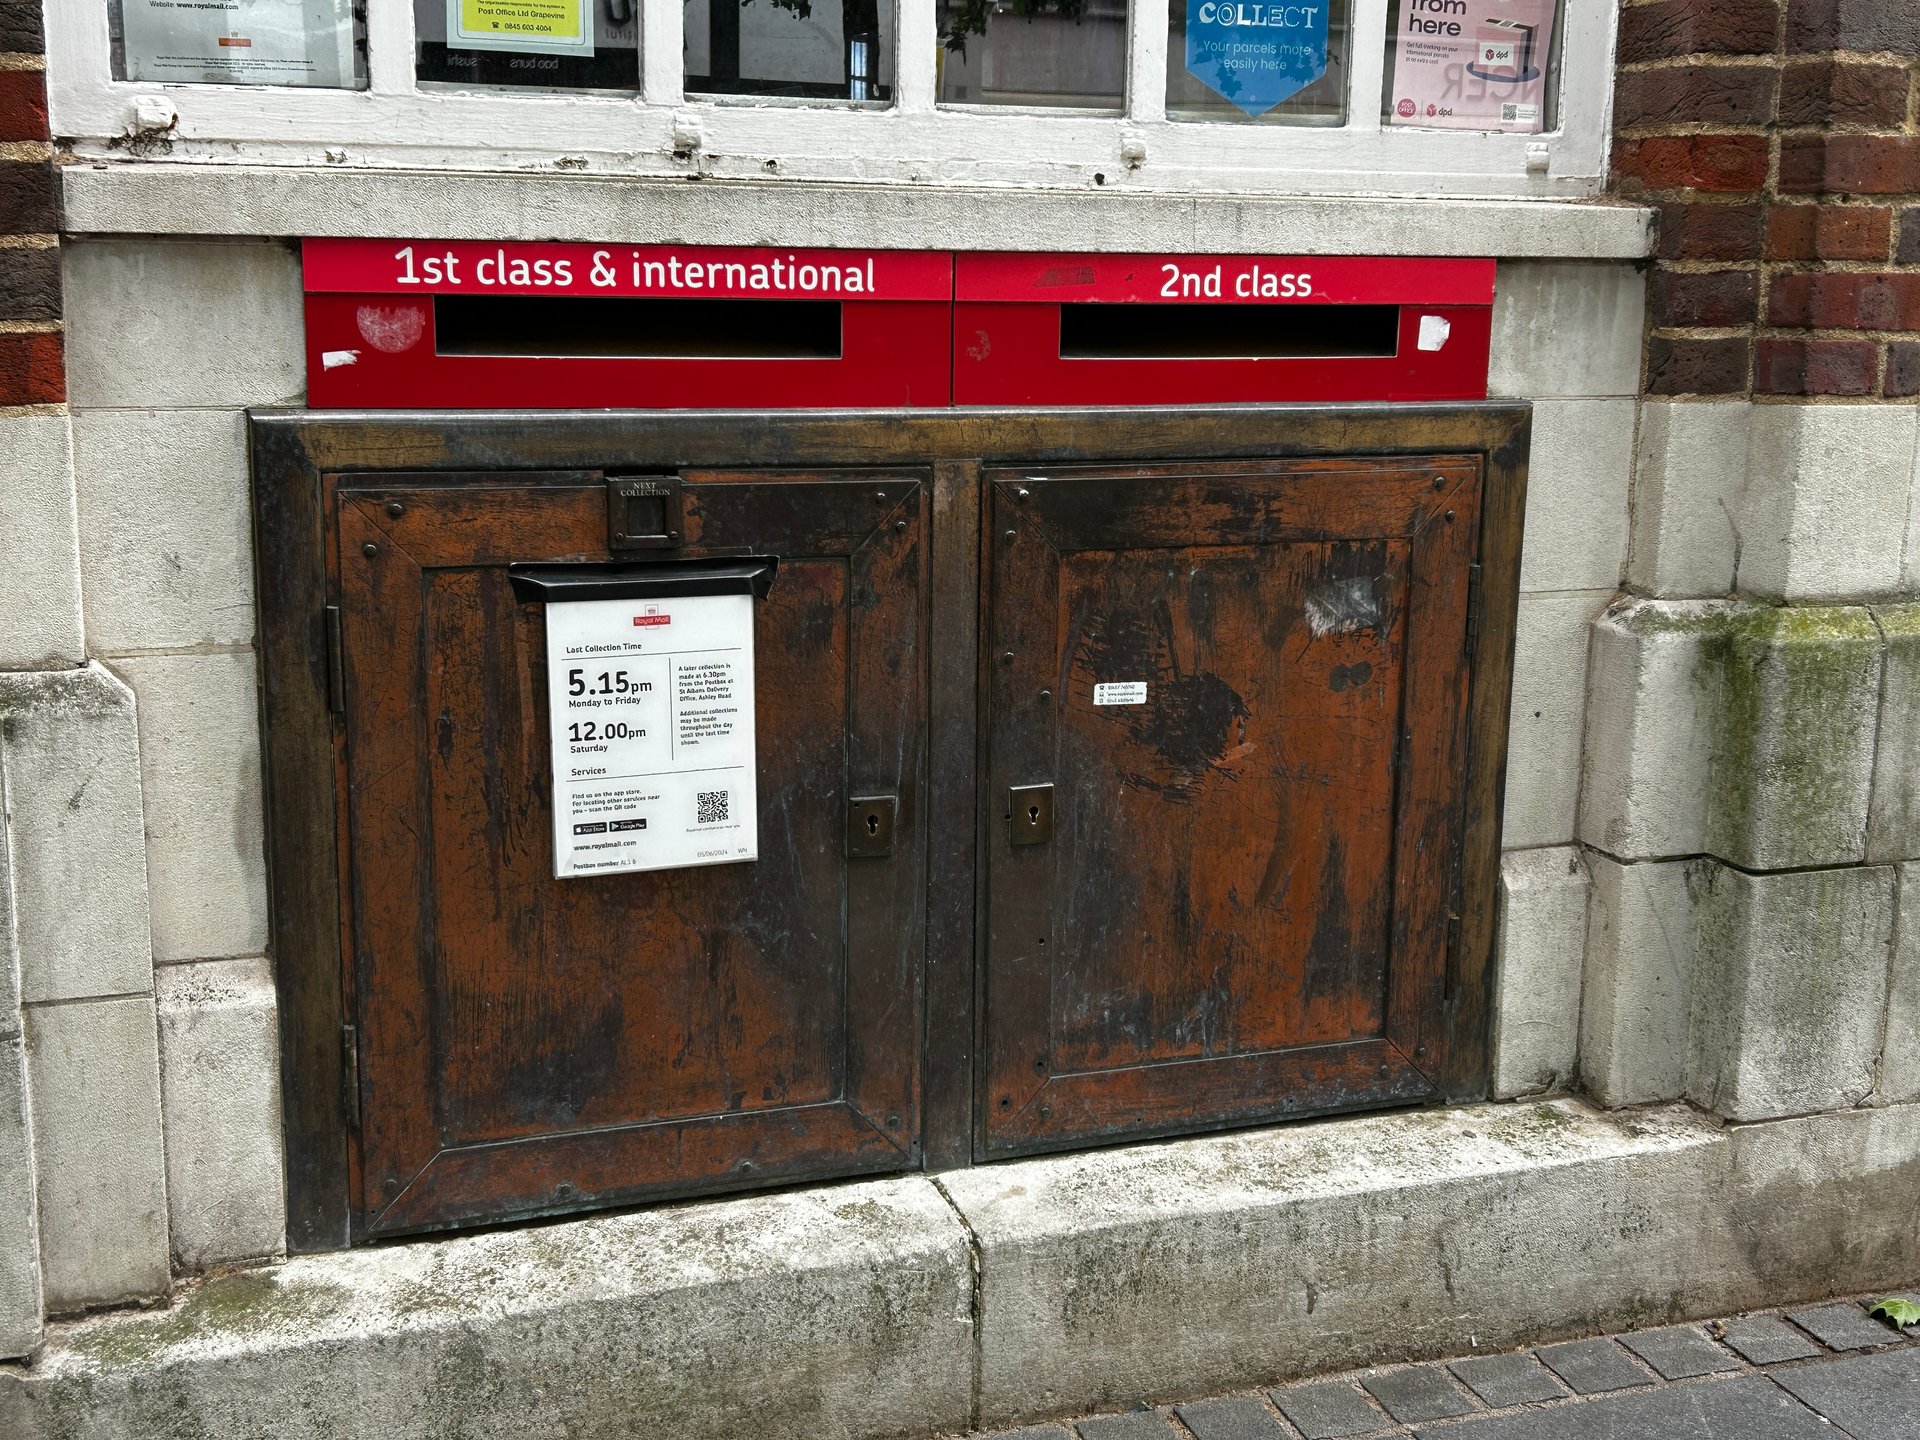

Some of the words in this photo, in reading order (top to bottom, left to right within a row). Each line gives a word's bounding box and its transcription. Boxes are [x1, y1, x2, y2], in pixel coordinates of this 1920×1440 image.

[176, 2, 239, 10] www.royalmail.com
[1411, 0, 1466, 15] from
[496, 8, 516, 16] Office
[530, 11, 565, 20] Grapevine
[1199, 2, 1318, 28] COLLECT
[504, 22, 520, 30] 0845
[1409, 14, 1462, 36] here
[1203, 40, 1230, 52] Your
[1234, 42, 1276, 56] parcels
[1280, 46, 1311, 55] more
[1496, 50, 1508, 60] dpd
[1224, 58, 1258, 72] easily
[1260, 58, 1286, 70] here
[1438, 107, 1452, 118] dpd
[396, 246, 461, 286] 1st
[476, 249, 573, 288] class
[590, 250, 617, 288] &
[632, 252, 875, 293] international
[1161, 264, 1222, 298] 2nd
[1235, 265, 1312, 298] class
[585, 644, 622, 652] Collection
[568, 668, 652, 696] 5.15pm
[569, 699, 602, 708] Monday
[604, 698, 612, 706] to
[616, 696, 642, 705] Friday
[568, 721, 646, 742] 12.00pm
[570, 744, 608, 754] Saturday
[572, 766, 606, 776] Services
[574, 840, 636, 851] www.royalmail.com
